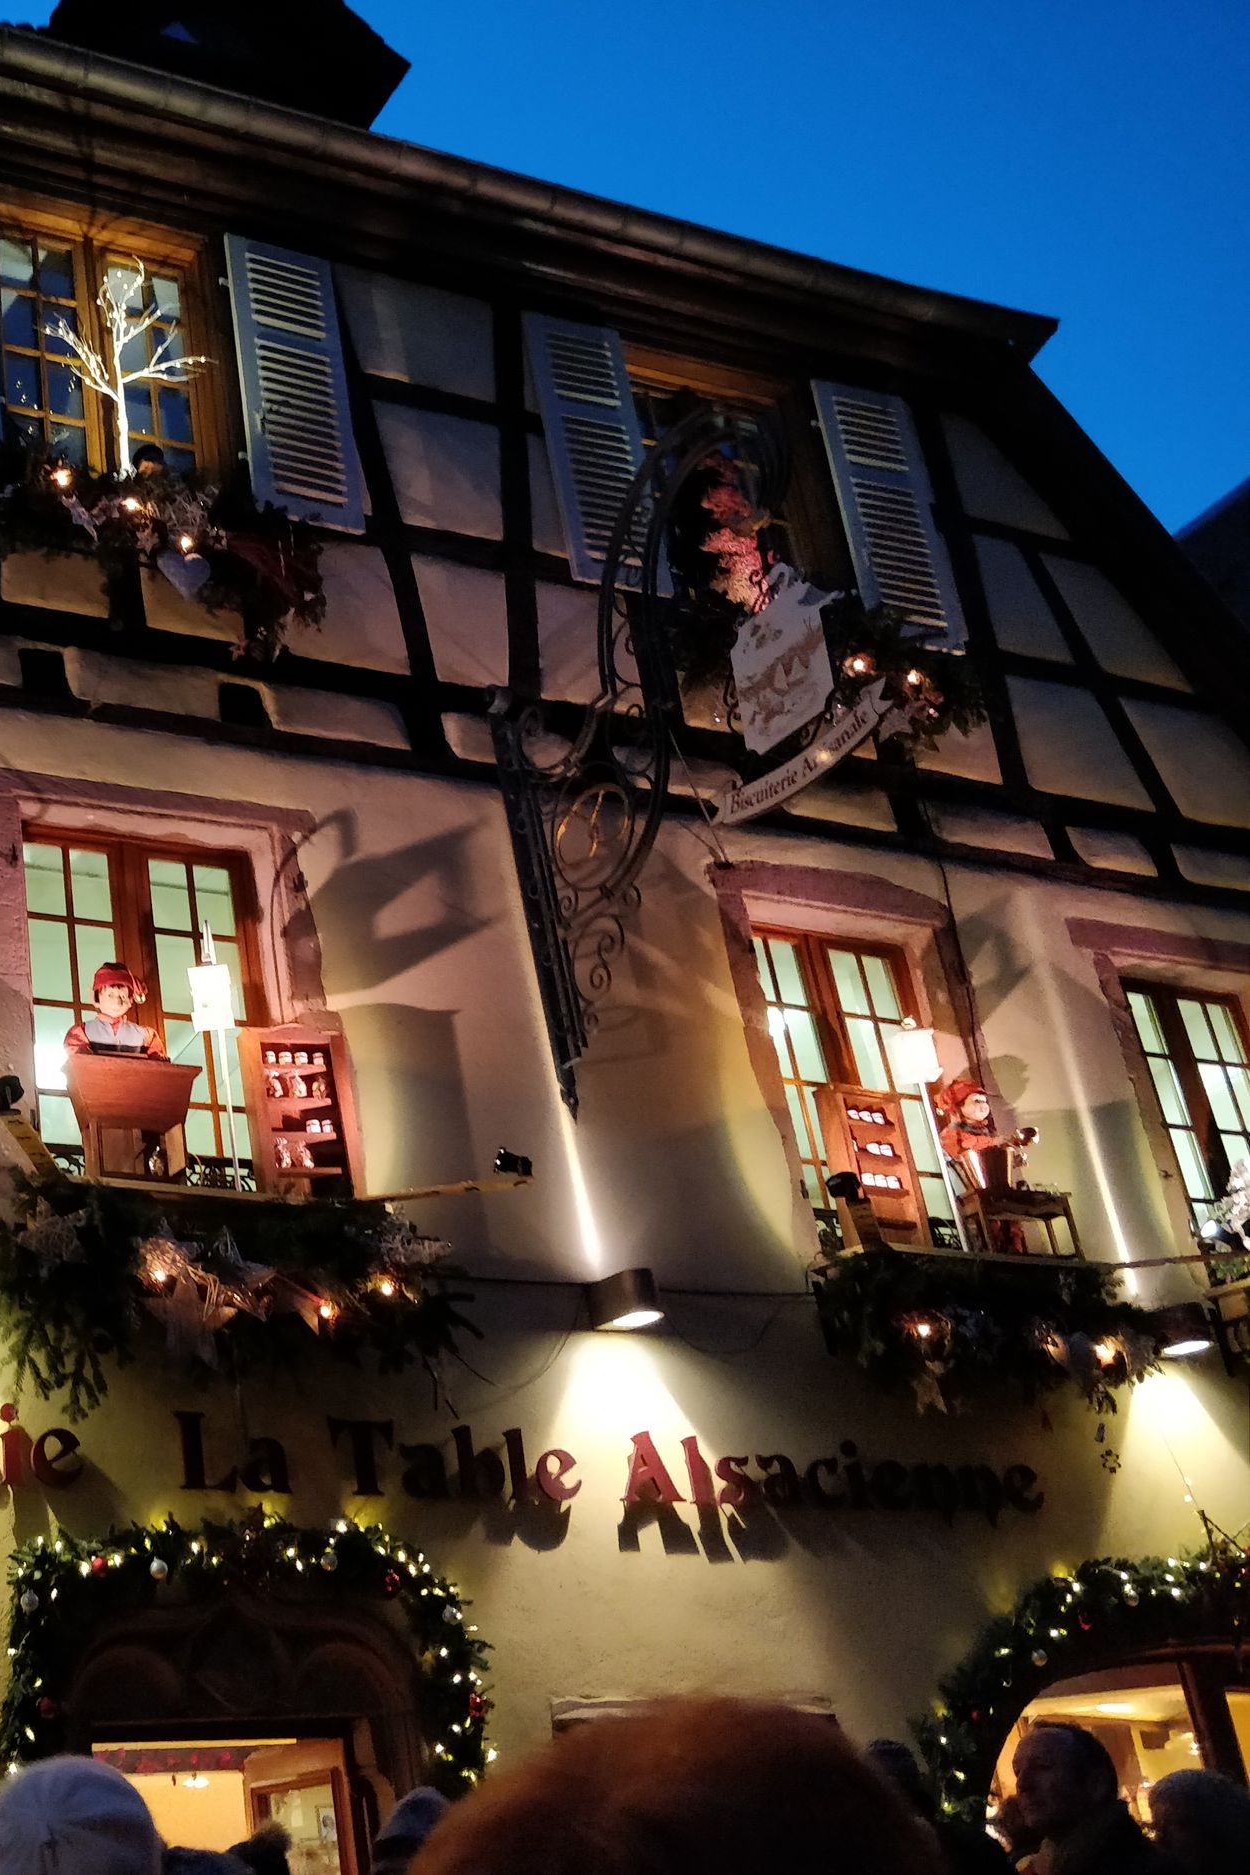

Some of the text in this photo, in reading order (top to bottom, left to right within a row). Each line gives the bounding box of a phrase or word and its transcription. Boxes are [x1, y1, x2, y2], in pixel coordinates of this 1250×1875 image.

[730, 709, 868, 814] Biscuiterie Arsanale
[173, 1410, 293, 1495] La
[326, 1415, 582, 1501] Table
[619, 1430, 1045, 1515] Alsacienne
